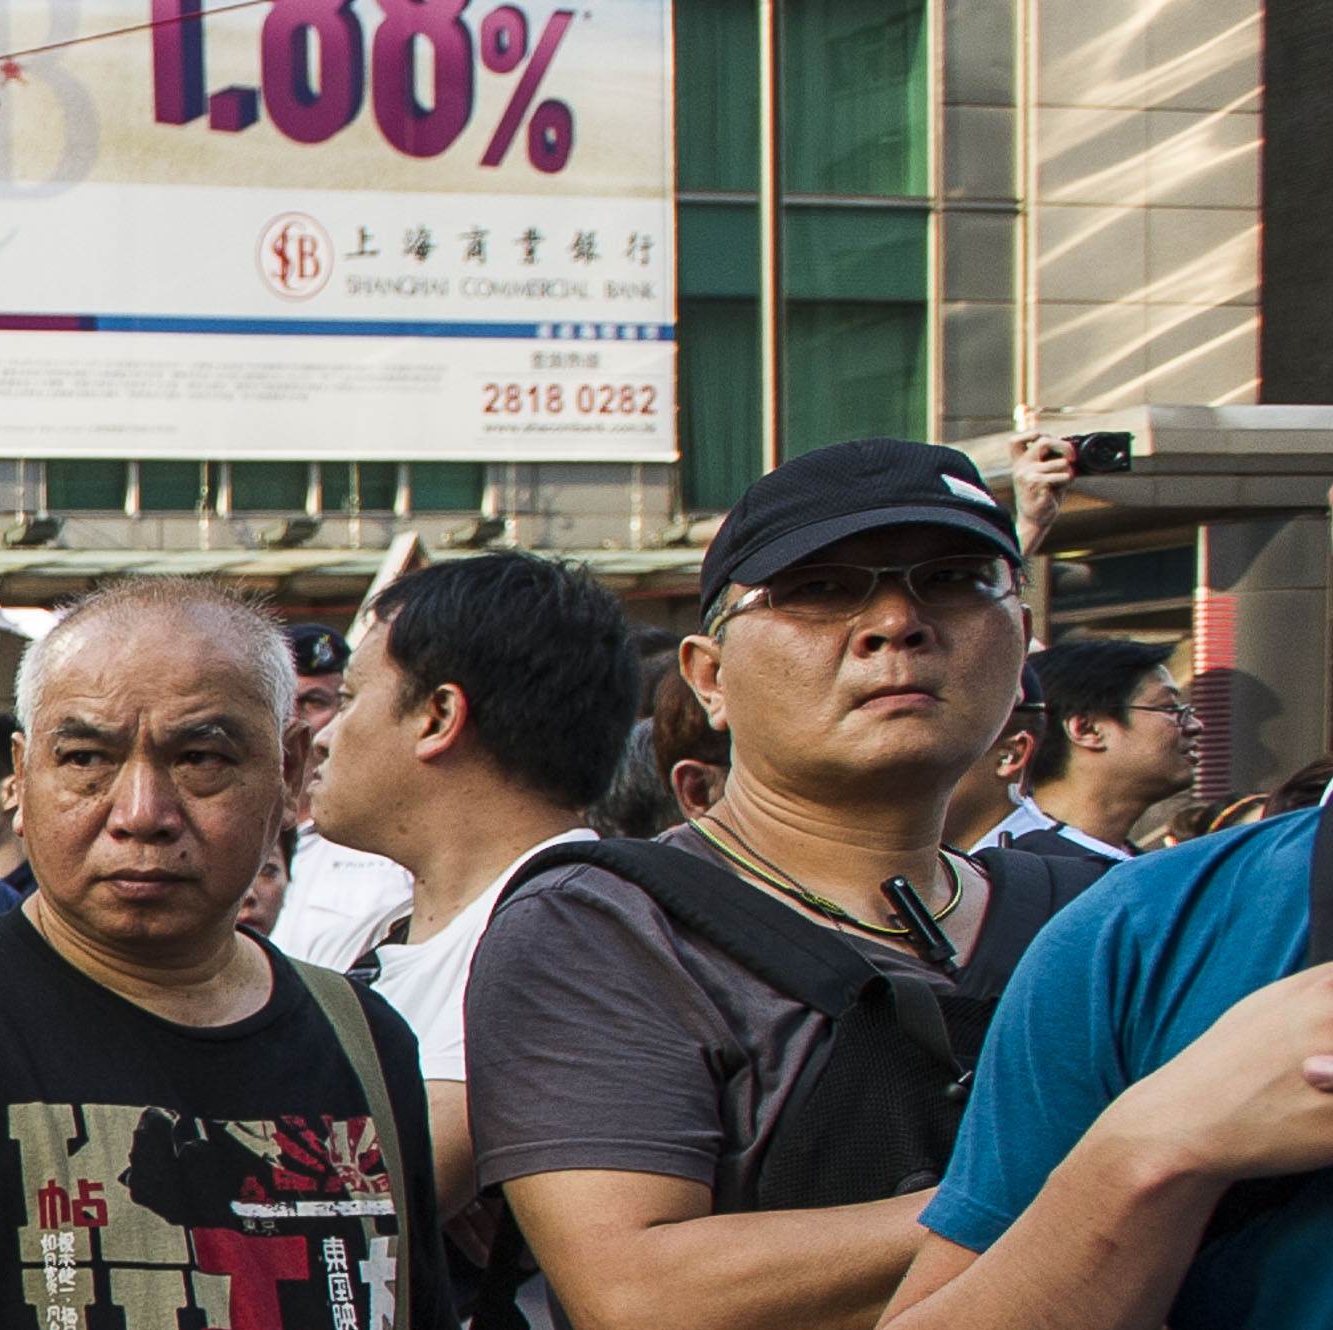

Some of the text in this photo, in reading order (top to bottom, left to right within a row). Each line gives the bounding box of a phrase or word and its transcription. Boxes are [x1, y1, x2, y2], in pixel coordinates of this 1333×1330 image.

[343, 224, 656, 267] 上海商業銀行
[345, 277, 656, 300] SHANGHAI COMMERCIAL BANK
[482, 381, 659, 416] 2818 0282
